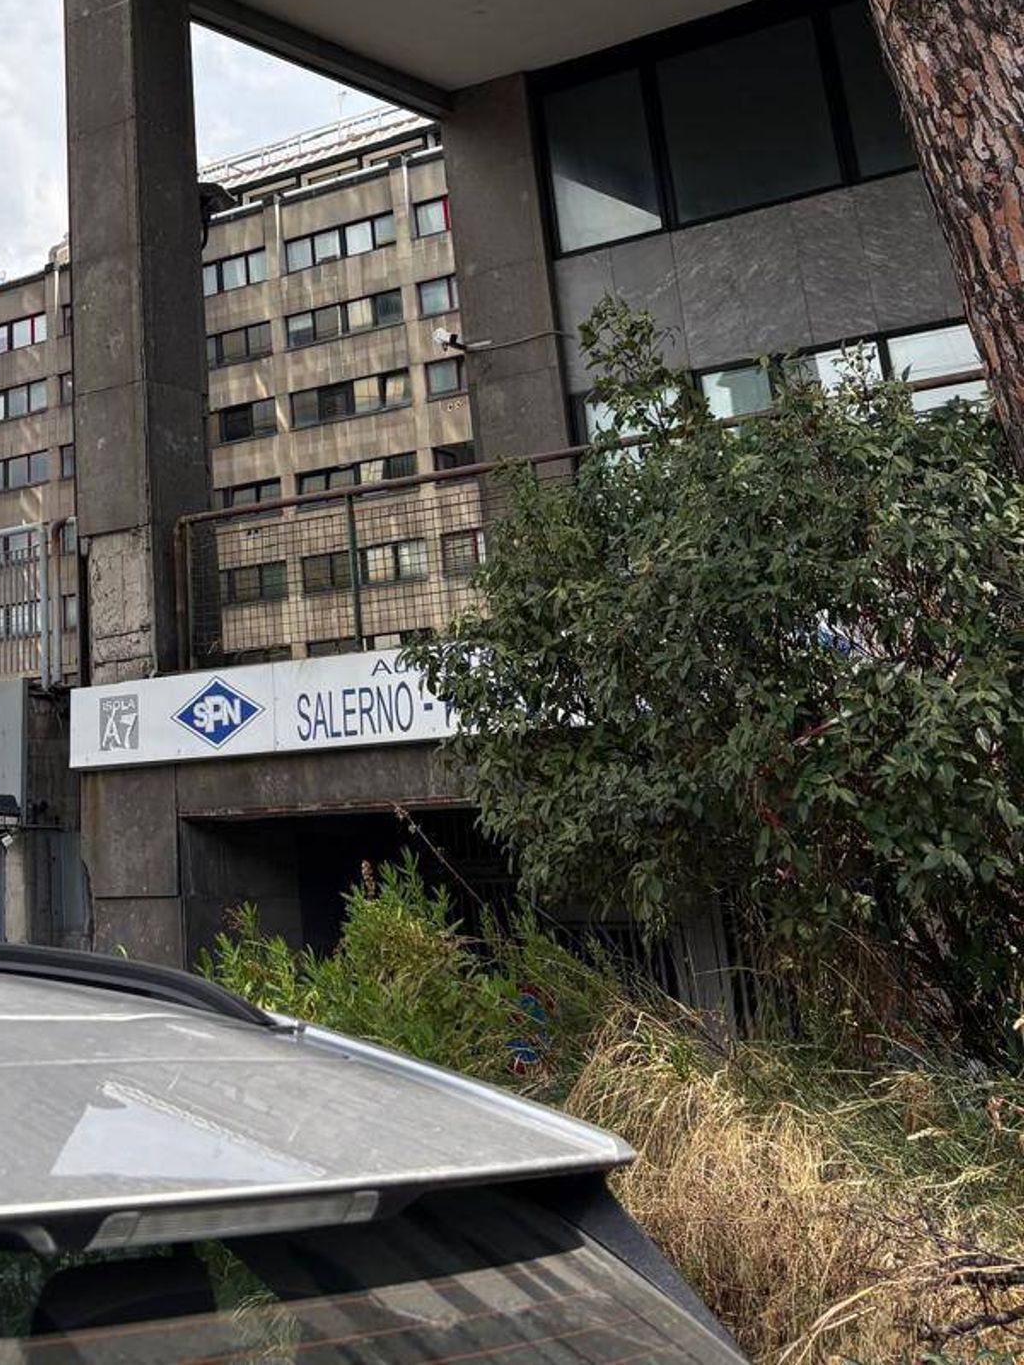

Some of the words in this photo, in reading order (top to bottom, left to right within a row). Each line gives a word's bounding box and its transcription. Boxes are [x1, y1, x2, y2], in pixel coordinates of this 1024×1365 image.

[102, 709, 137, 748] A7
[193, 695, 242, 733] SPN
[297, 681, 414, 742] SALERNO
